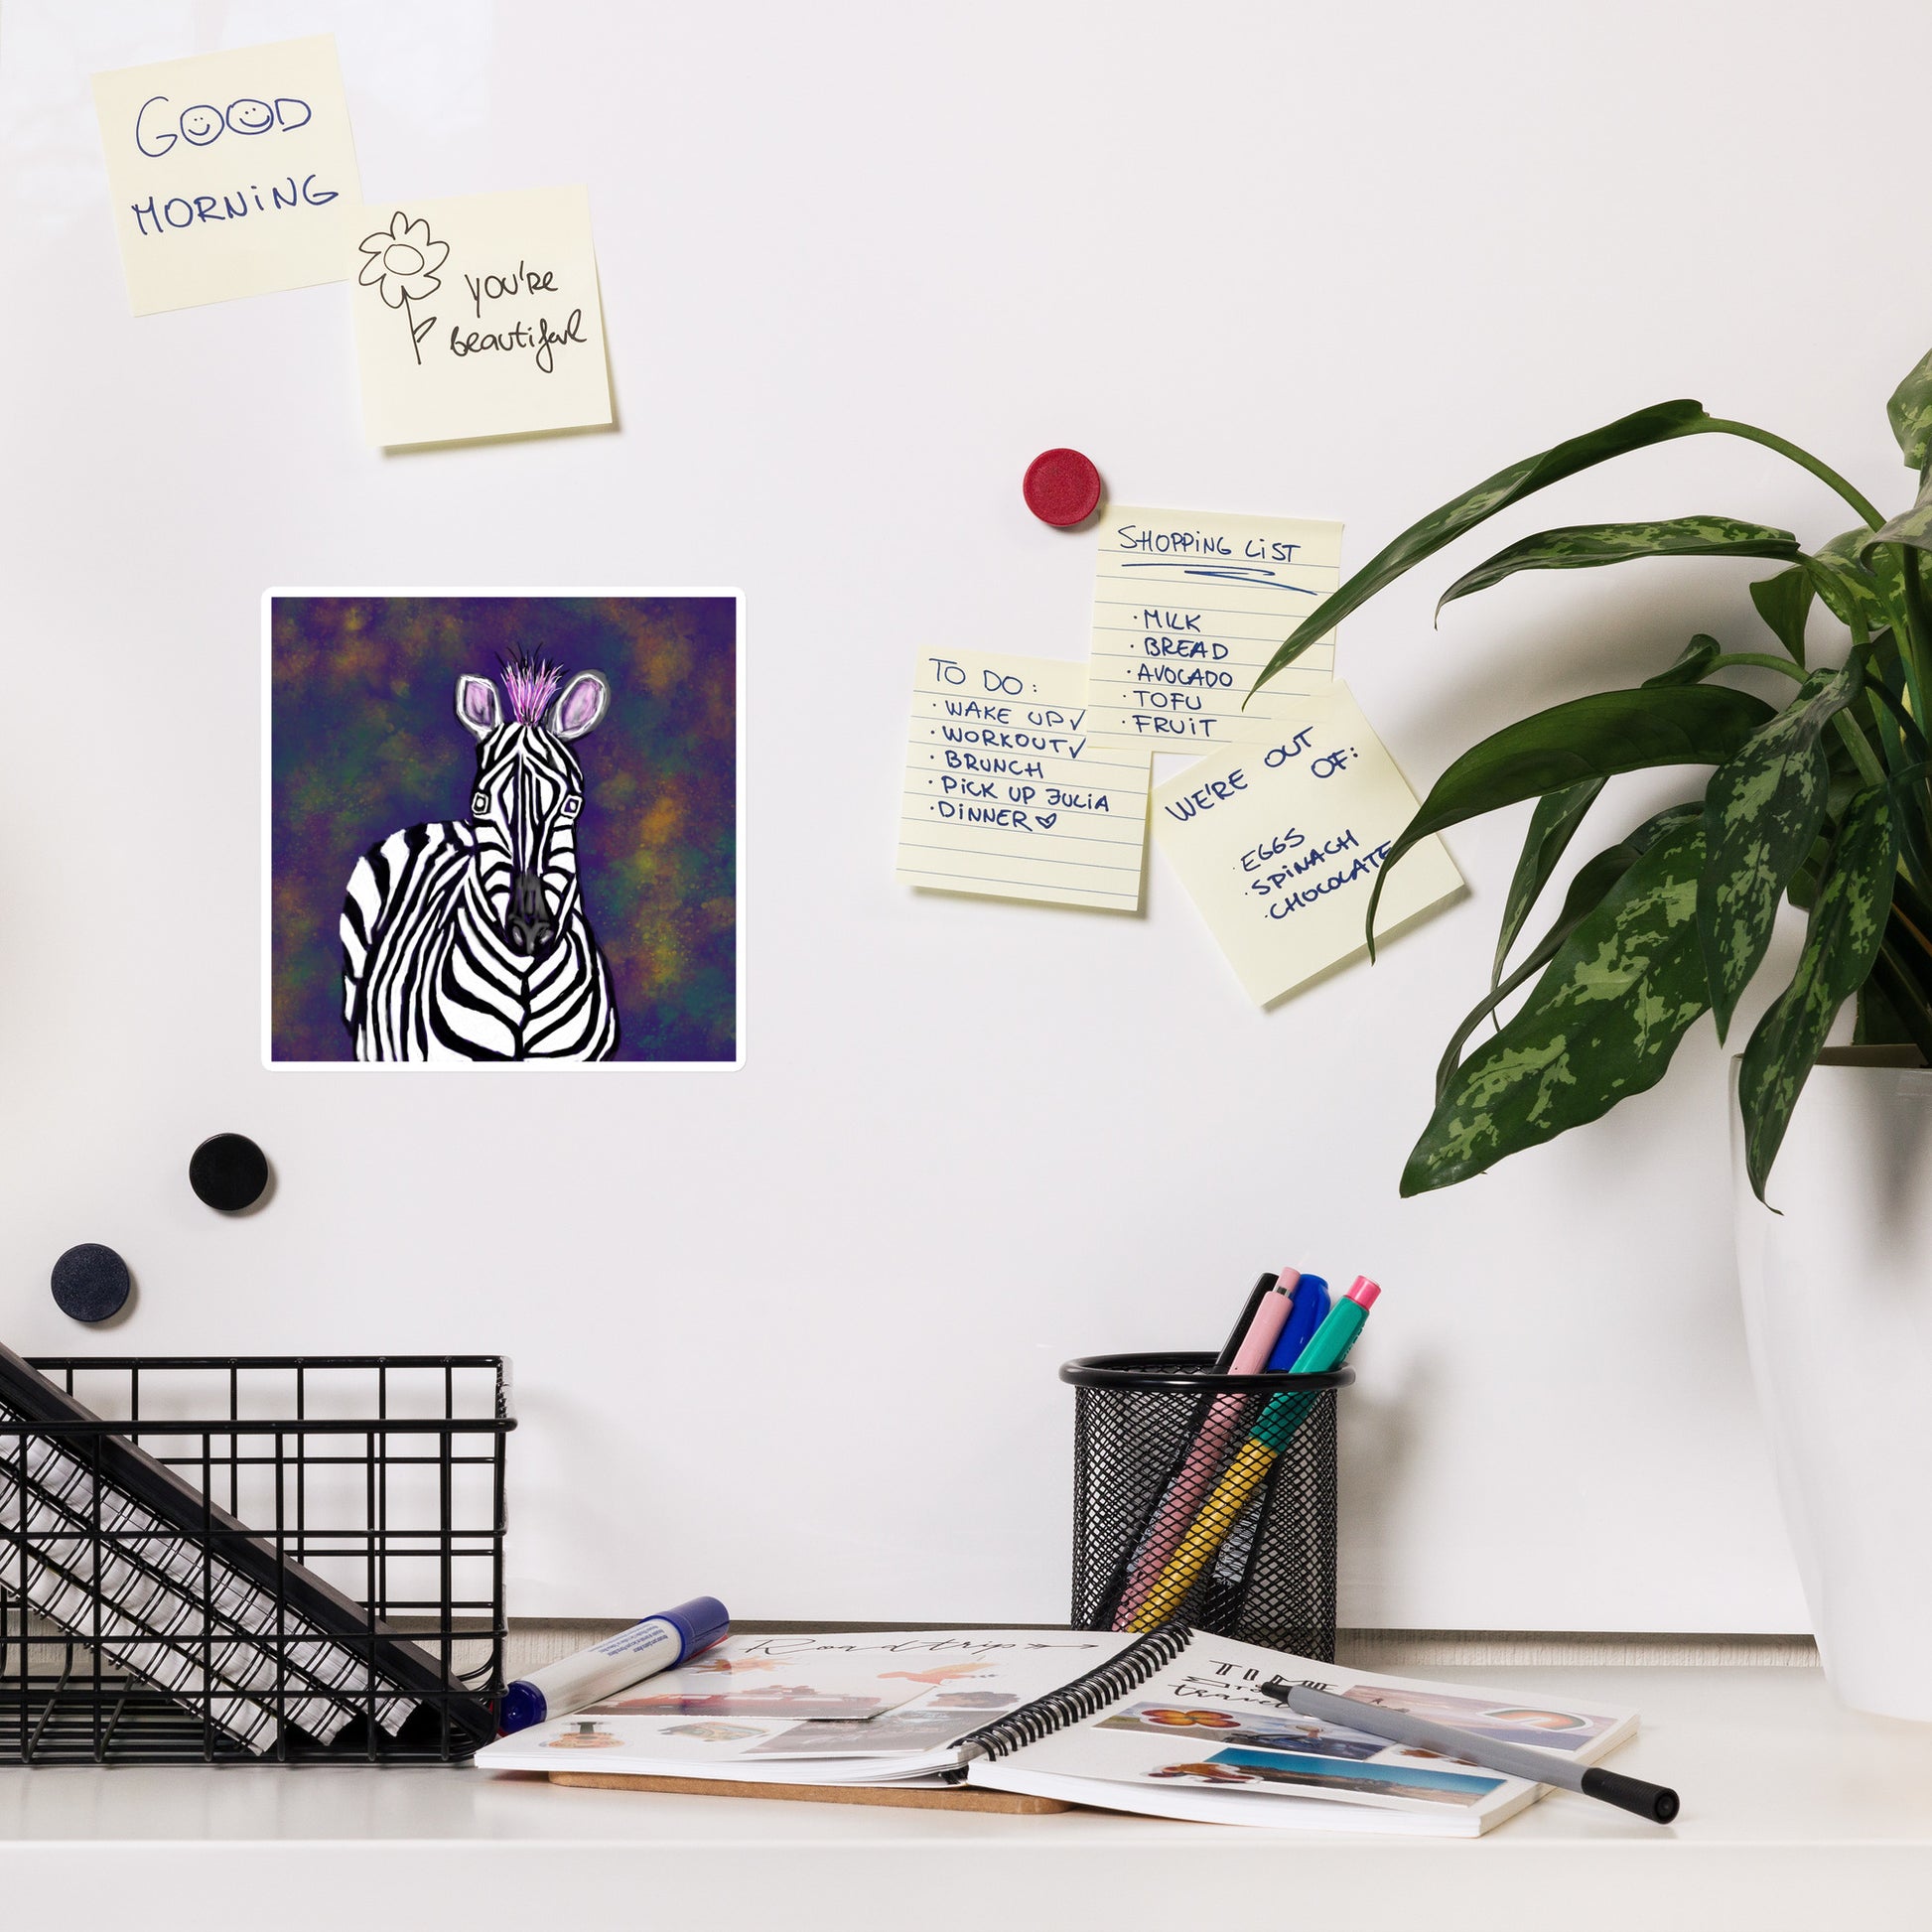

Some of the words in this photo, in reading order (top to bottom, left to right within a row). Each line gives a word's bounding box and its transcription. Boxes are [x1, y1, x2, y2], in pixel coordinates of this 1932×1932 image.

[135, 95, 312, 158] GOOD
[464, 259, 559, 318] you're
[449, 308, 588, 374] beautiful
[1144, 609, 1201, 632] MILK
[1144, 636, 1229, 660] BREAD
[928, 657, 966, 685] TO
[1137, 663, 1233, 688] AVOCADO
[944, 700, 1012, 725] WAKE
[1027, 710, 1064, 728] UP
[1133, 690, 1202, 711] TOFU
[941, 725, 1068, 754] WORKOUT
[944, 750, 1044, 779] BRUNCH
[1165, 768, 1248, 822] WE'RE
[1264, 726, 1314, 768] OUT
[1311, 747, 1359, 778] OF:
[1008, 785, 1035, 805] UP
[1240, 827, 1306, 873] EGGS
